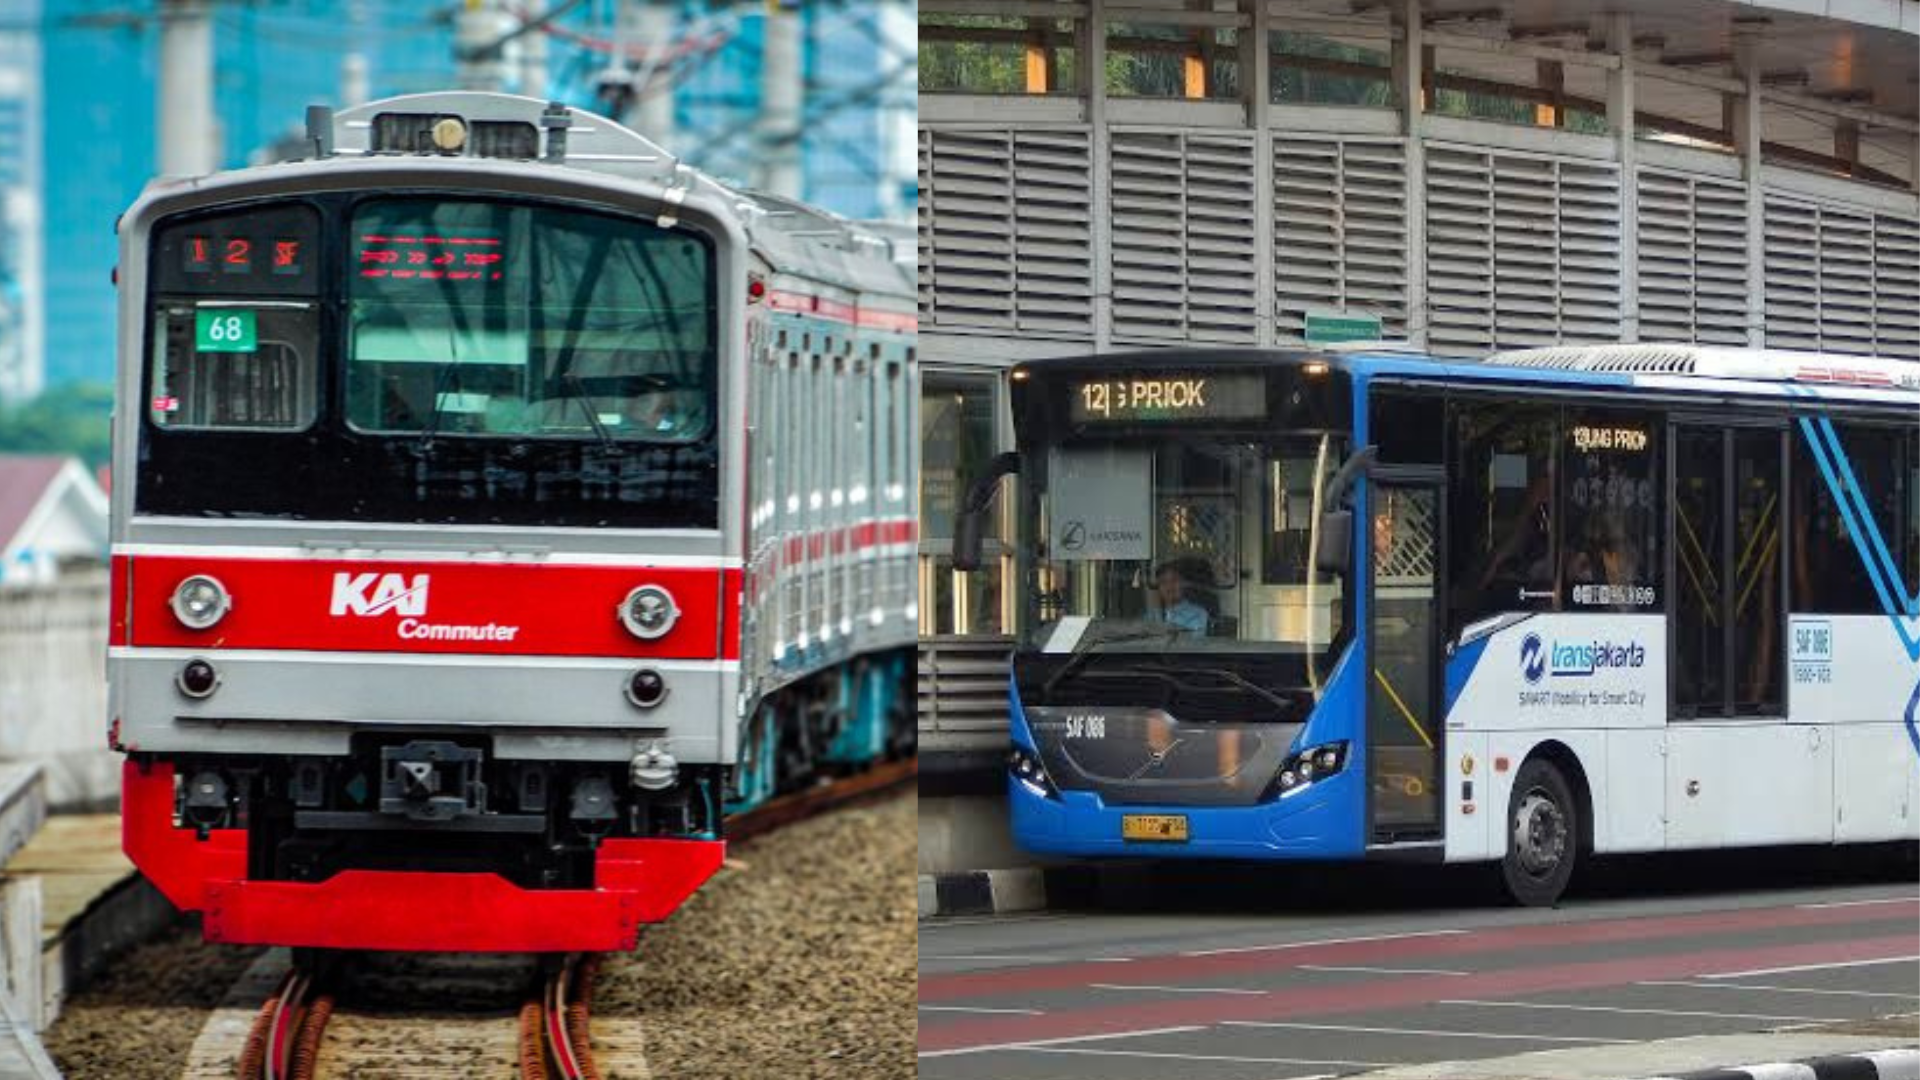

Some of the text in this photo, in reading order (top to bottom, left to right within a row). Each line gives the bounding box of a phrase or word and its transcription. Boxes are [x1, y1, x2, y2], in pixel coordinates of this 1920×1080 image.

[209, 316, 242, 341] 68
[1131, 380, 1205, 408] PRIOK
[329, 572, 430, 616] KAI
[397, 618, 519, 640] Commuter
[1551, 640, 1644, 676] transjakarta
[1066, 715, 1084, 738] SAF
